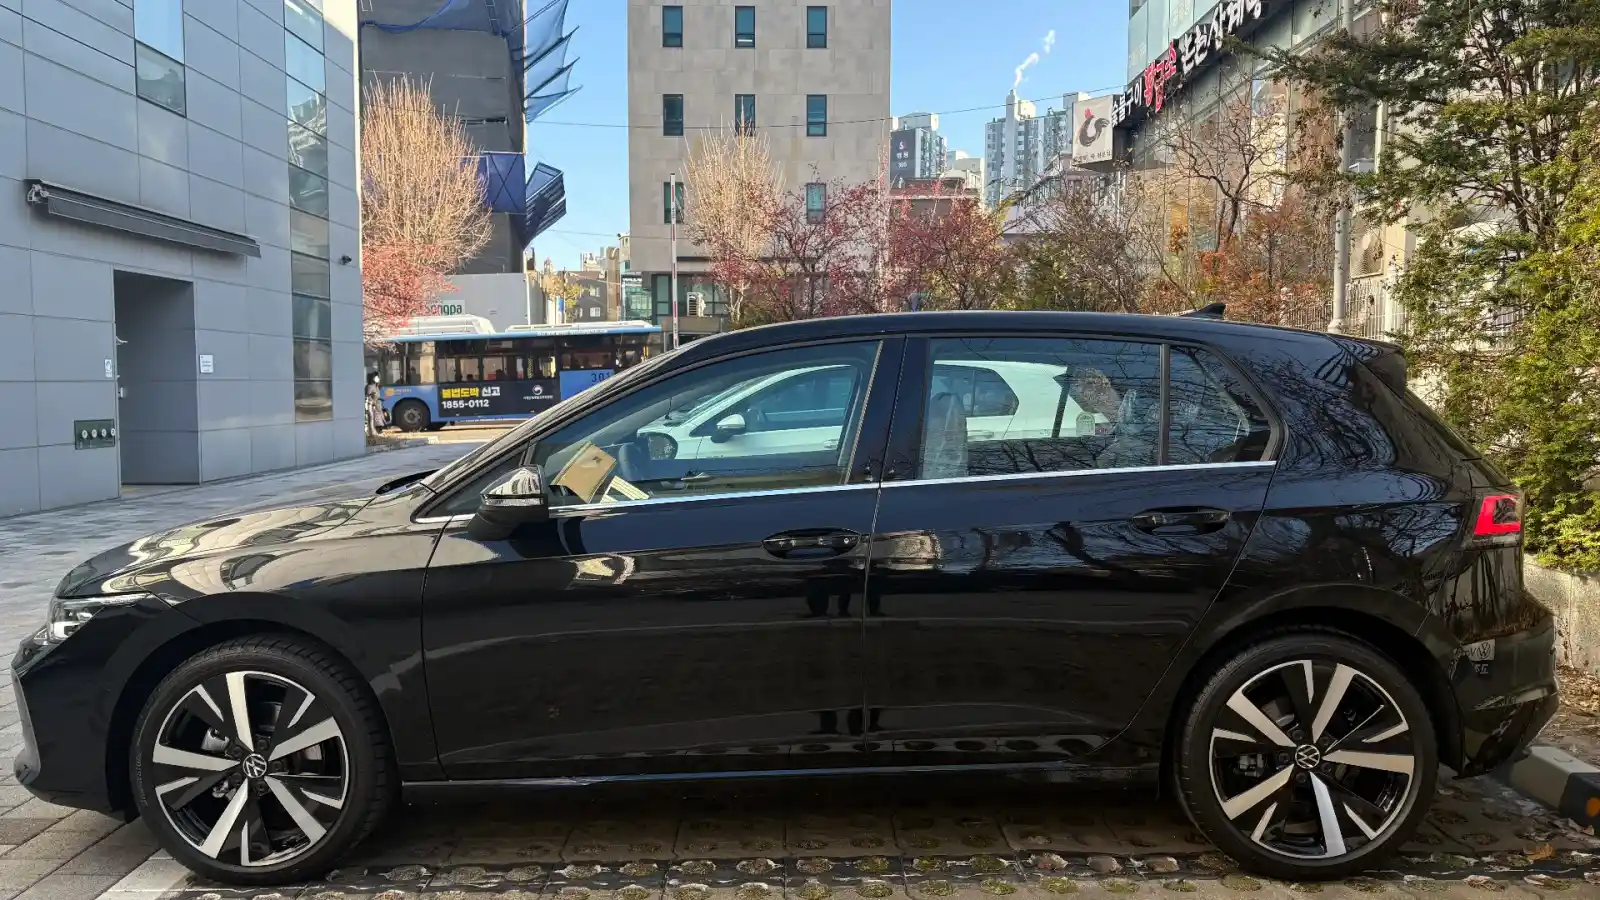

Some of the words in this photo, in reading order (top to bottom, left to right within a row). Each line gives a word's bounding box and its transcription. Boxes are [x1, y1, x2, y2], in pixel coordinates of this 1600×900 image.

[441, 387, 479, 399] 불법도박
[481, 386, 501, 397] 신고
[441, 399, 490, 409] 1855-0112
